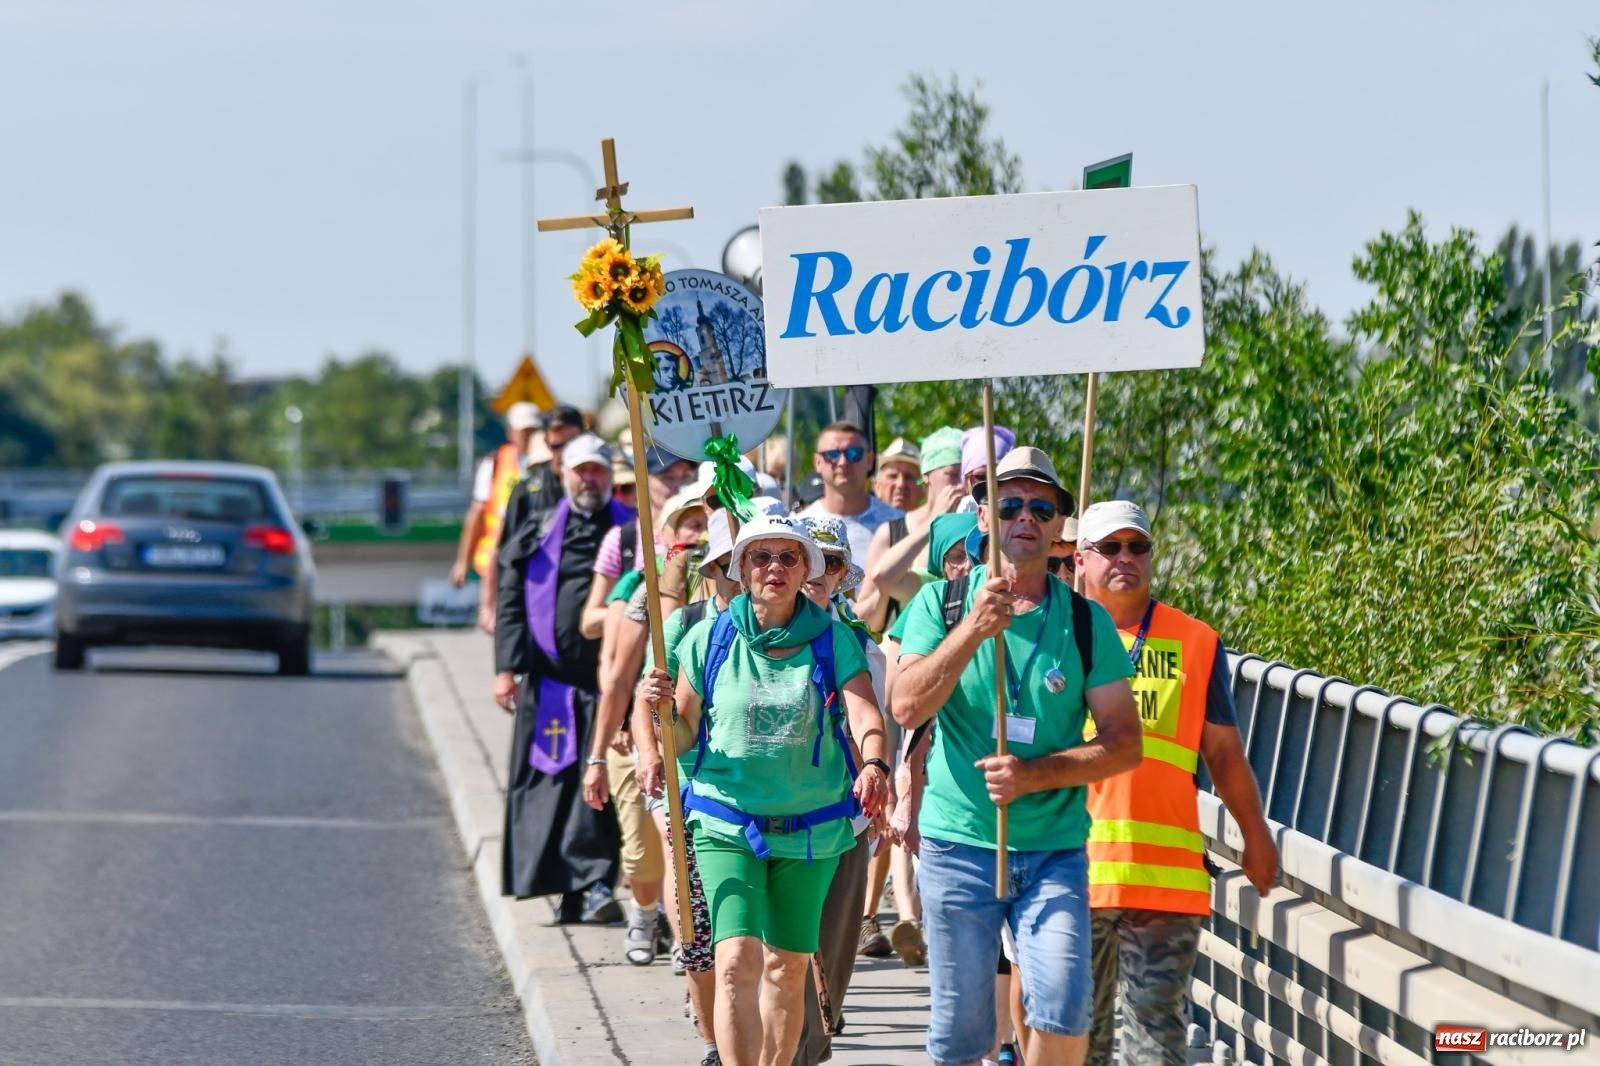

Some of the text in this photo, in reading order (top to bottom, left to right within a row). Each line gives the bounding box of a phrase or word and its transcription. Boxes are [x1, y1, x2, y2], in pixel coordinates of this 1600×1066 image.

[678, 276, 749, 308] TOMASZA
[780, 235, 1191, 339] Racibórz
[649, 383, 775, 426] KIETRZ
[769, 518, 793, 527] FILA
